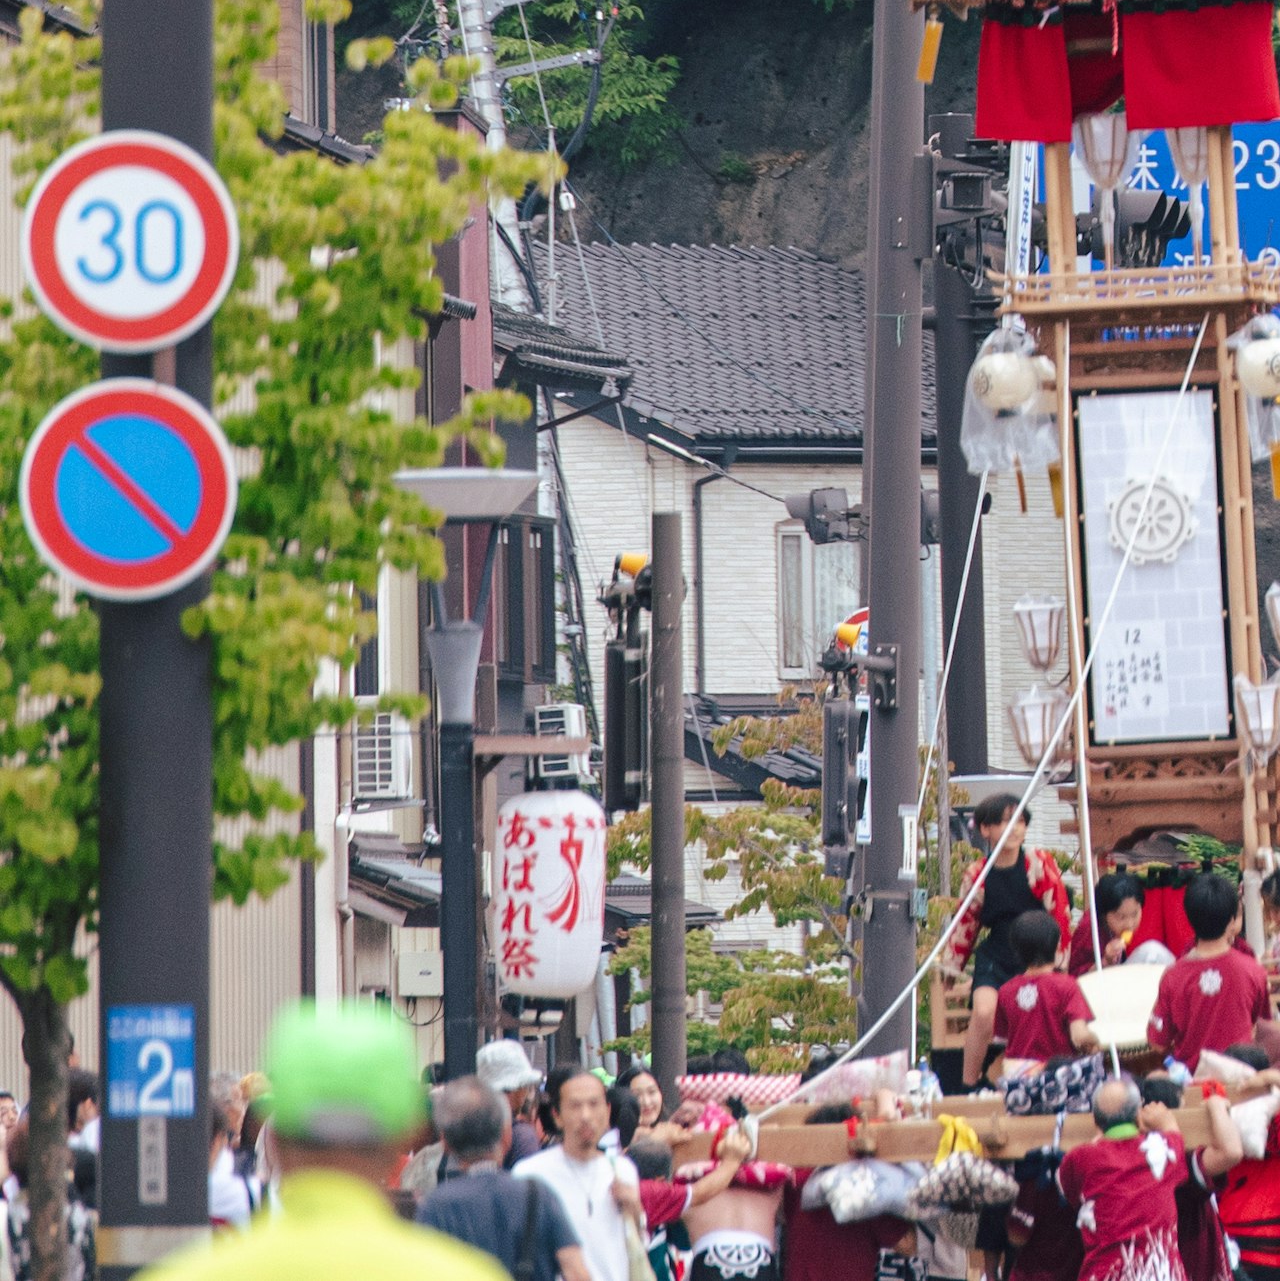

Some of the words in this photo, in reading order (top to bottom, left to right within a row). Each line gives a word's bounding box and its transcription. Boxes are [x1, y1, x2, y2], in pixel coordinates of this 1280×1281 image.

[76, 199, 185, 286] 30
[501, 810, 539, 979] あばれ祭
[138, 1038, 195, 1115] 2m
